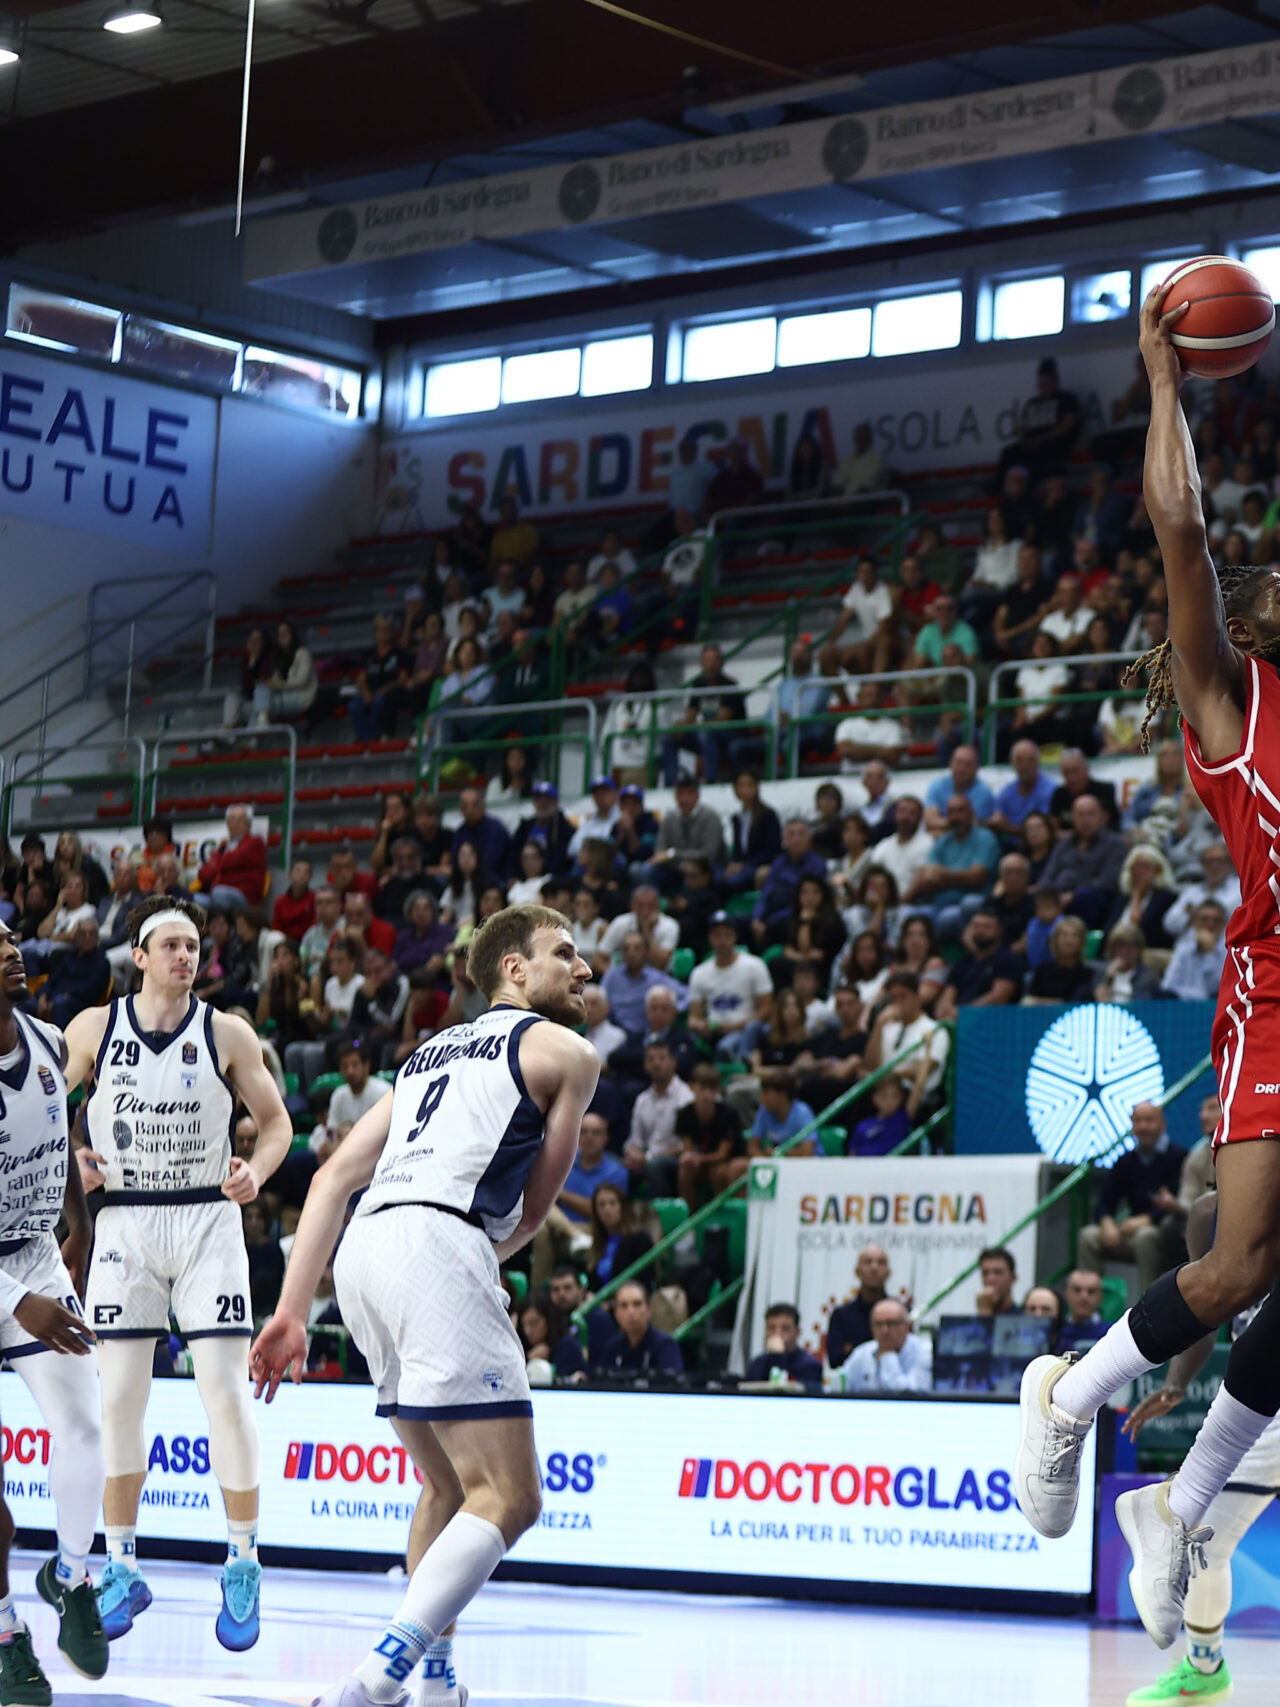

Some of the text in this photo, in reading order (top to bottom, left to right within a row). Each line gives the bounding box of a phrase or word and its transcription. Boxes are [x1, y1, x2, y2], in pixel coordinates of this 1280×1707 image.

[1172, 60, 1248, 93] Banco
[877, 113, 946, 141] Banco
[969, 89, 1075, 123] Sardegna
[608, 160, 671, 187] Banco
[694, 137, 791, 170] Sardegna
[364, 202, 422, 231] Banco
[442, 180, 531, 213] Sardegna
[876, 404, 983, 453] SOLA
[110, 1039, 141, 1067] 29
[113, 1091, 202, 1116] Dinamo
[406, 1072, 450, 1143] 9
[135, 1119, 201, 1136] Banco di
[135, 1137, 207, 1156] Sardegna
[141, 1168, 191, 1182] REALE
[799, 1194, 988, 1225] SARDEGNA
[215, 1294, 247, 1323] 29
[29, 1481, 51, 1498] PE
[141, 1490, 210, 1509] ABREZZA
[714, 1459, 1023, 1512] DOCTORGLAS
[311, 1499, 330, 1517] LA
[335, 1501, 377, 1520] CURA
[537, 1513, 592, 1530] REZZA
[710, 1519, 1041, 1554] LA CURA PER IL TUO PARABREZZA
[373, 1632, 416, 1682] DS
